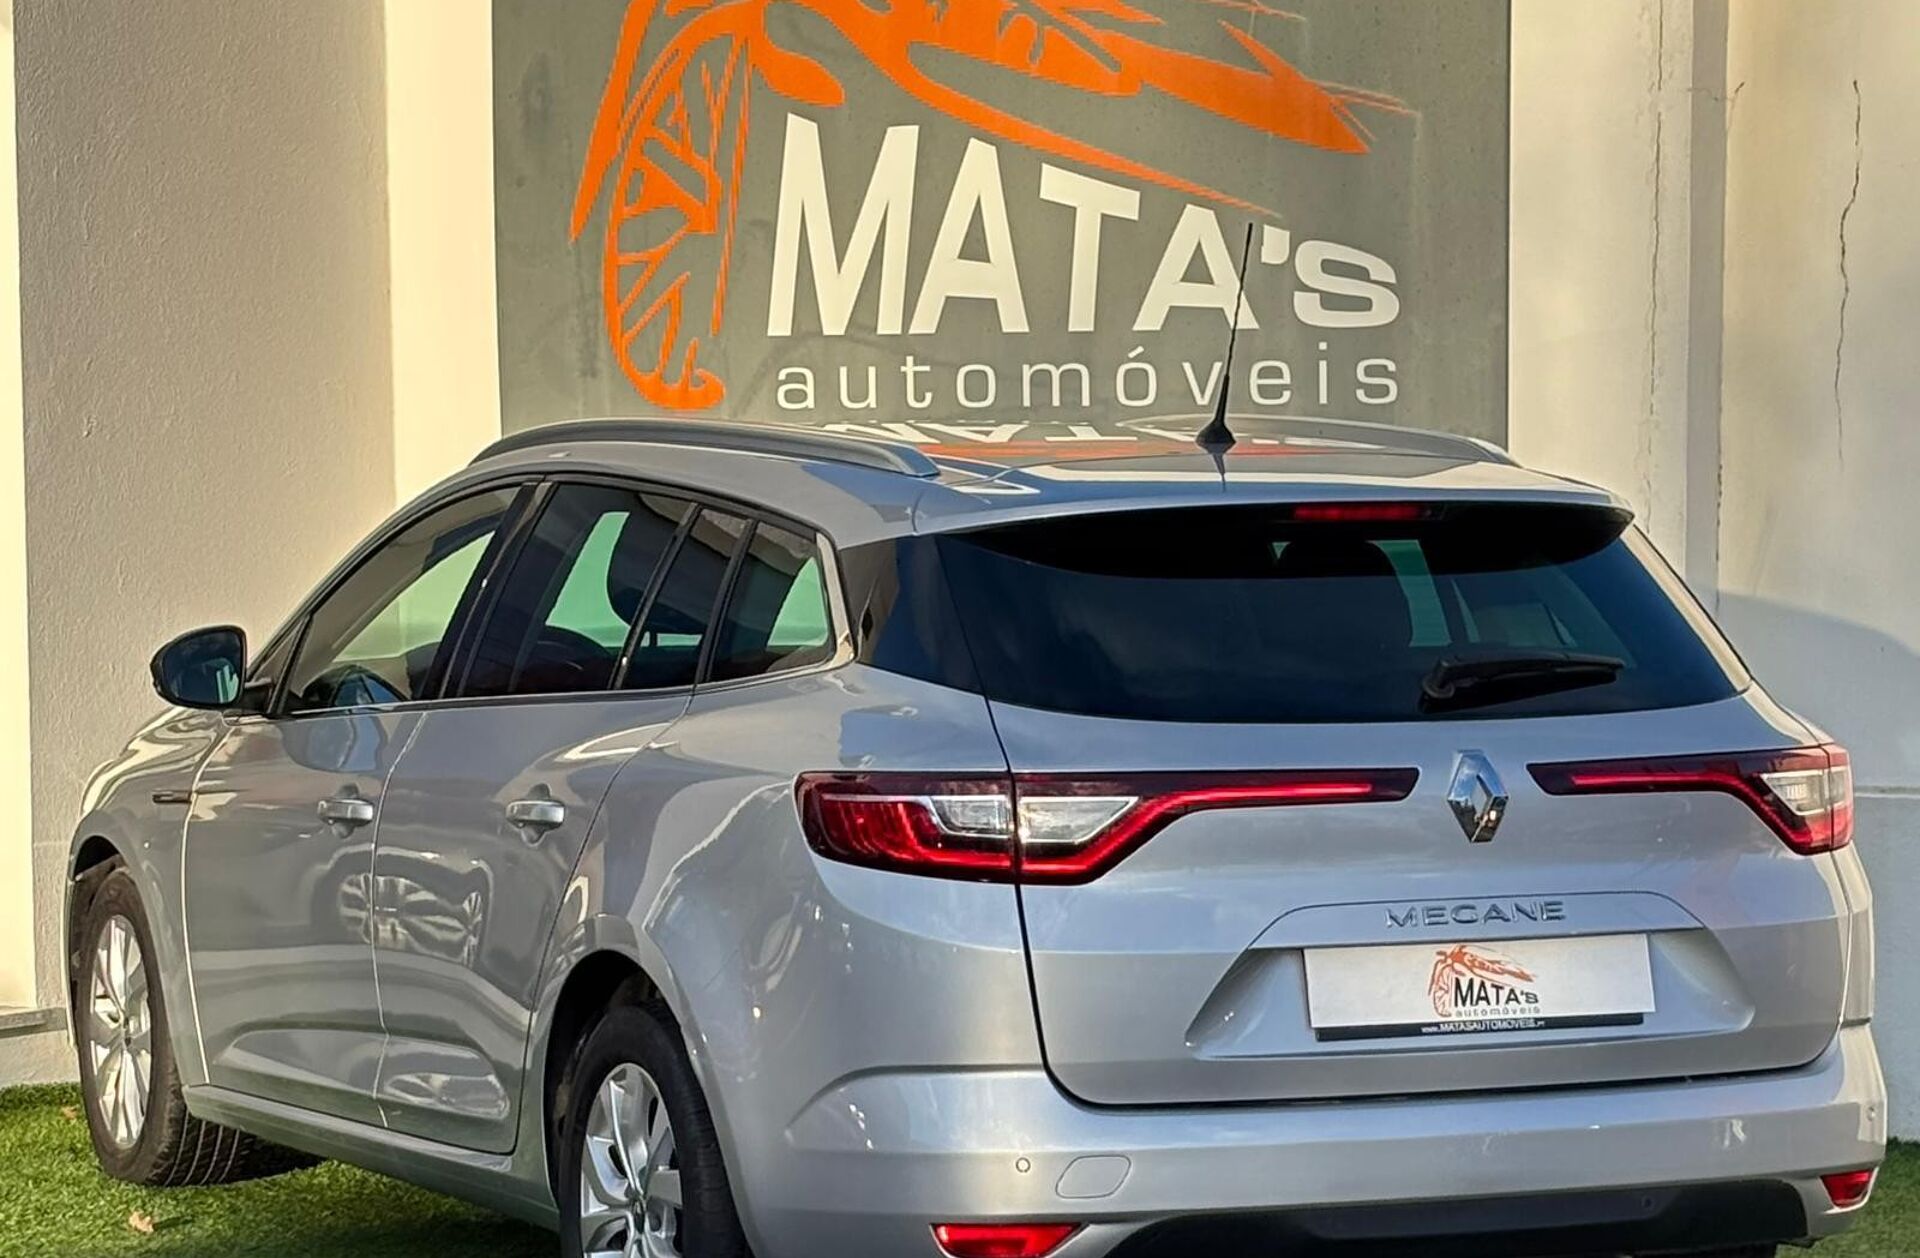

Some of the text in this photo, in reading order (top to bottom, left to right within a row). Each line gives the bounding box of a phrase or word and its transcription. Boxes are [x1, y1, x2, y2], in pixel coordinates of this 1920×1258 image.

[767, 112, 1400, 337] MATA's
[775, 341, 1399, 409] automóveis
[1386, 900, 1566, 928] MEGANE
